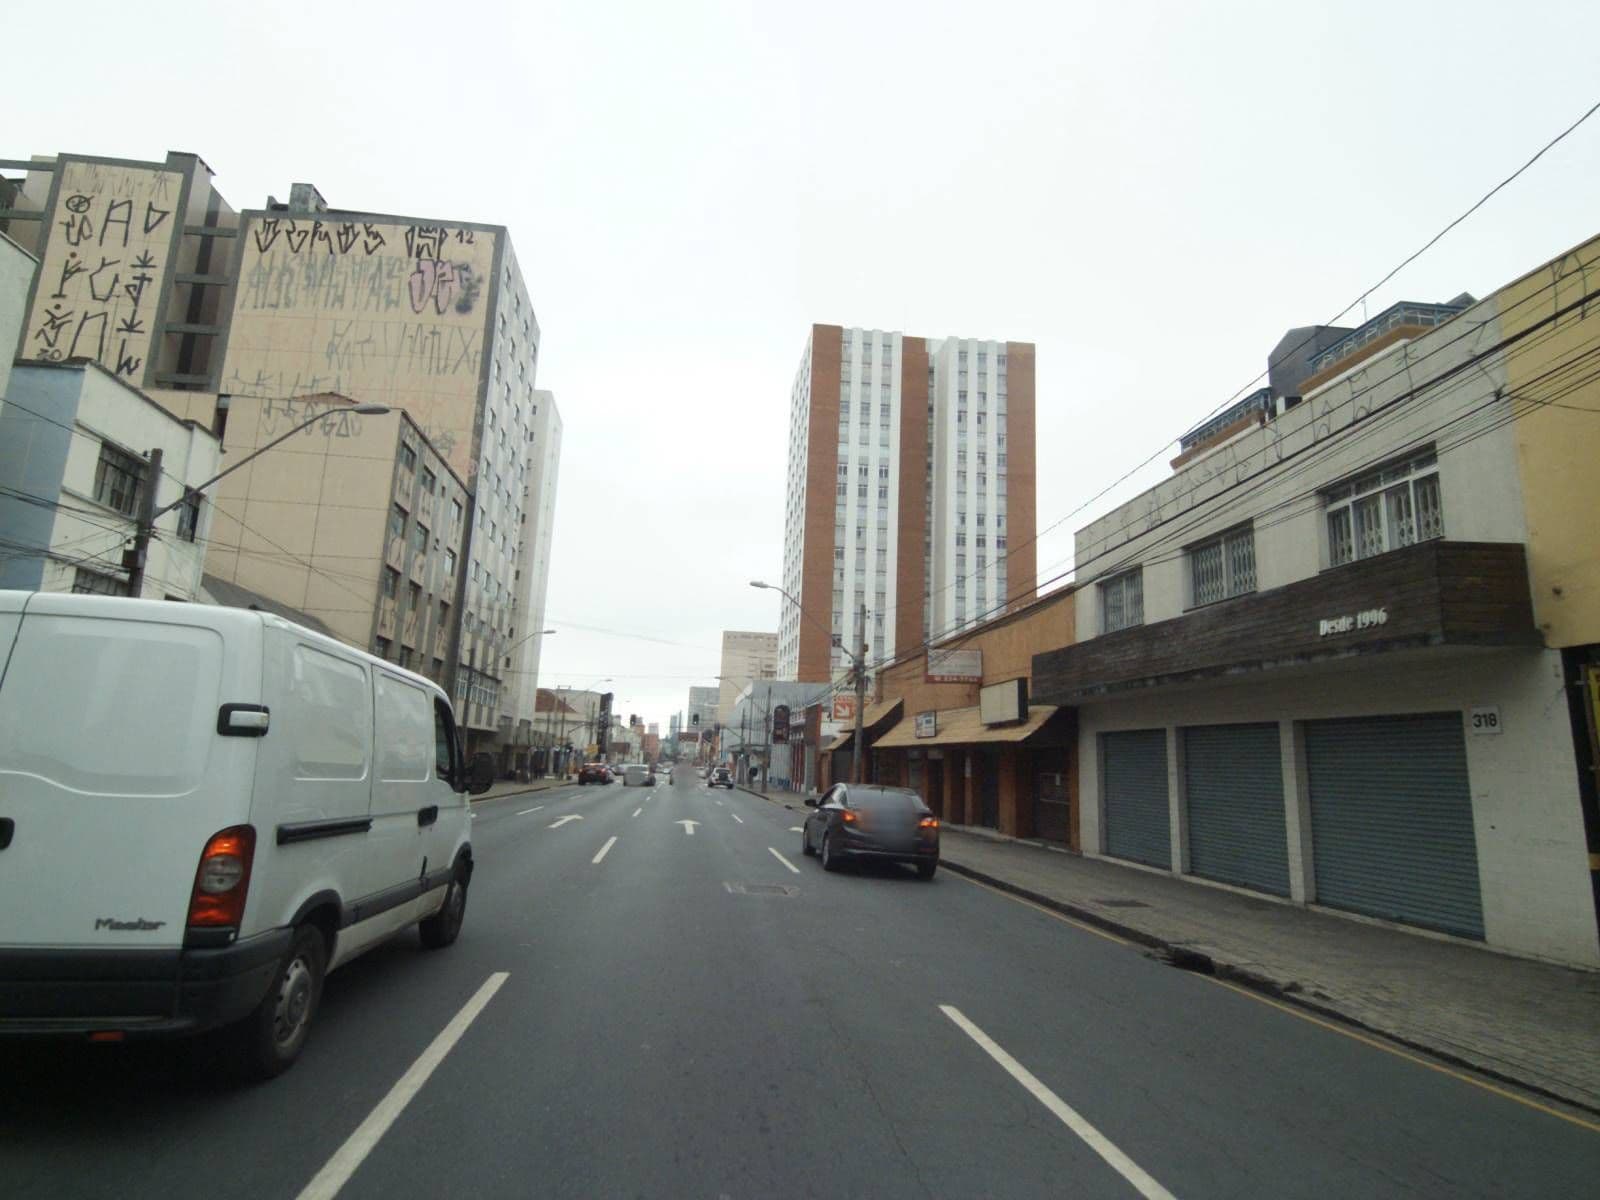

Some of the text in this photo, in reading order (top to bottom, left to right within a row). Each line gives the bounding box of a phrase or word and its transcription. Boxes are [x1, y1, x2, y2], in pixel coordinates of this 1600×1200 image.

[1319, 607, 1387, 636] Desde 1996
[1472, 712, 1497, 728] 318
